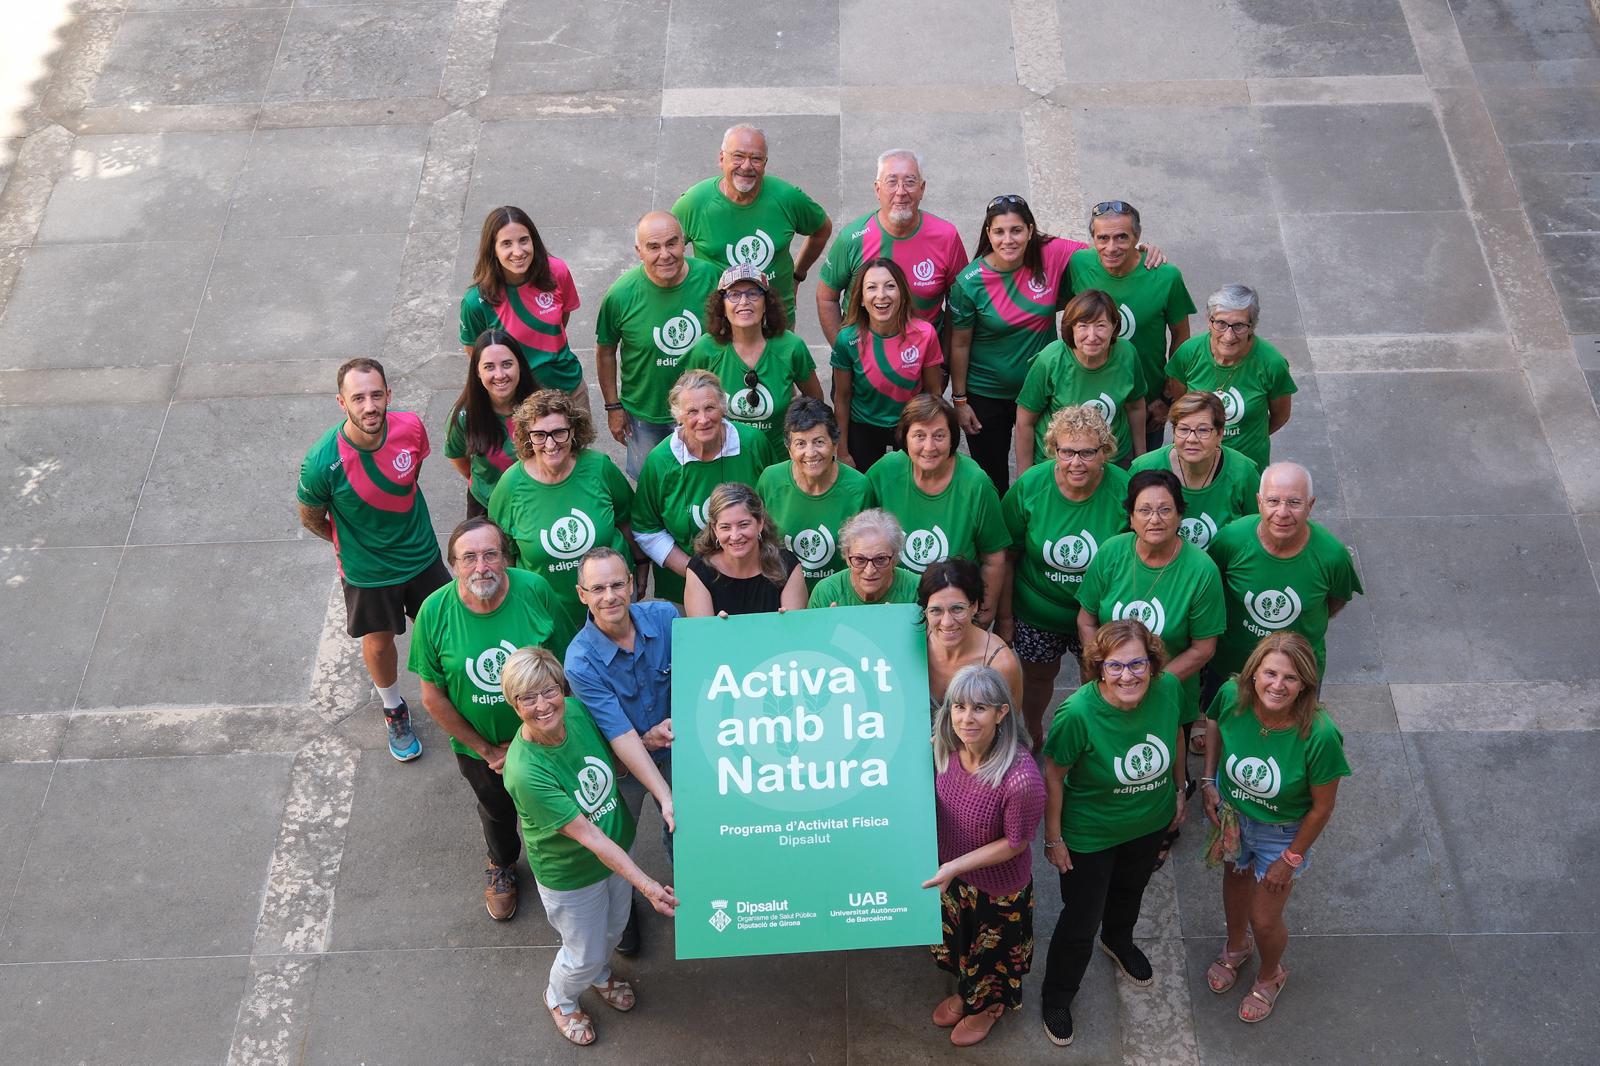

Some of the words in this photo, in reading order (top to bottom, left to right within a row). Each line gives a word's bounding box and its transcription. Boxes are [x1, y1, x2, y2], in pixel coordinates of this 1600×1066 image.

[329, 457, 345, 472] Marc
[548, 560, 579, 572] #dips
[1044, 571, 1083, 584] #dipsa
[1242, 619, 1272, 637] #dips
[707, 656, 892, 700] Activa't
[471, 694, 506, 706] #dips
[717, 705, 824, 746] amb
[843, 703, 885, 740] la
[718, 755, 888, 795] Natura
[1229, 787, 1278, 811] dipsalut
[720, 822, 782, 837] Programa
[779, 833, 831, 847] Dipsalut
[848, 891, 888, 907] UAB
[736, 900, 788, 915] Dipsalut
[830, 908, 869, 917] Universitat
[870, 906, 908, 914] Autònoma
[737, 915, 769, 924] Organisme
[779, 912, 795, 920] Salut
[737, 921, 768, 930] Diputació
[769, 920, 778, 928] de
[779, 919, 801, 928] Girona
[856, 914, 893, 923] Barcelona
